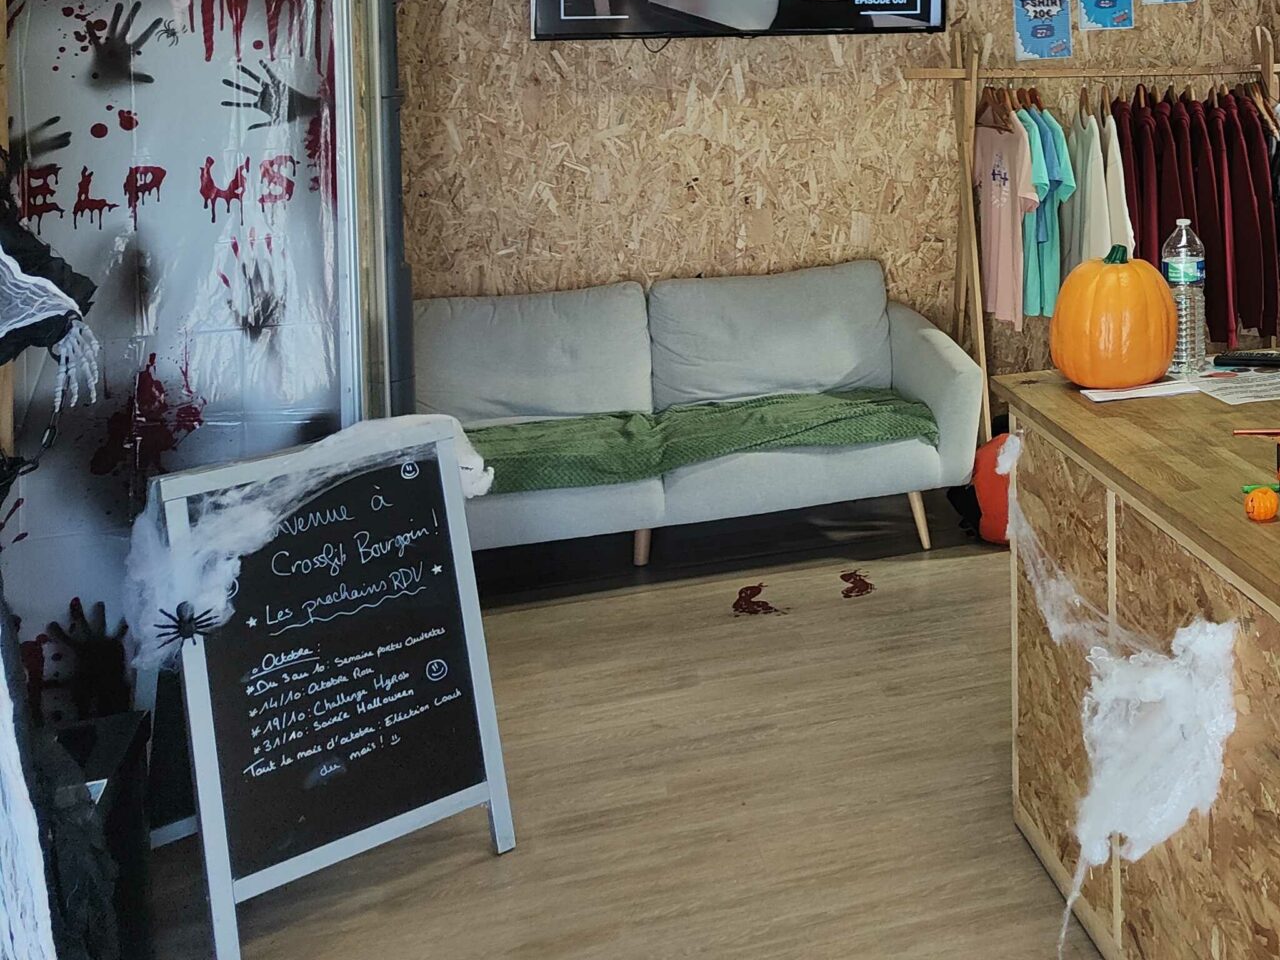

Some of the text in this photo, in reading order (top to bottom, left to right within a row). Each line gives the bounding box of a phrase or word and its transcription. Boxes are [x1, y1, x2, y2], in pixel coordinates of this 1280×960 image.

[1032, 9, 1053, 19] 20€
[16, 162, 168, 235] ELP
[370, 485, 393, 511] à
[265, 561, 423, 625] Les prochains RDV
[313, 689, 369, 717] Challenge
[356, 688, 415, 715] Halloween
